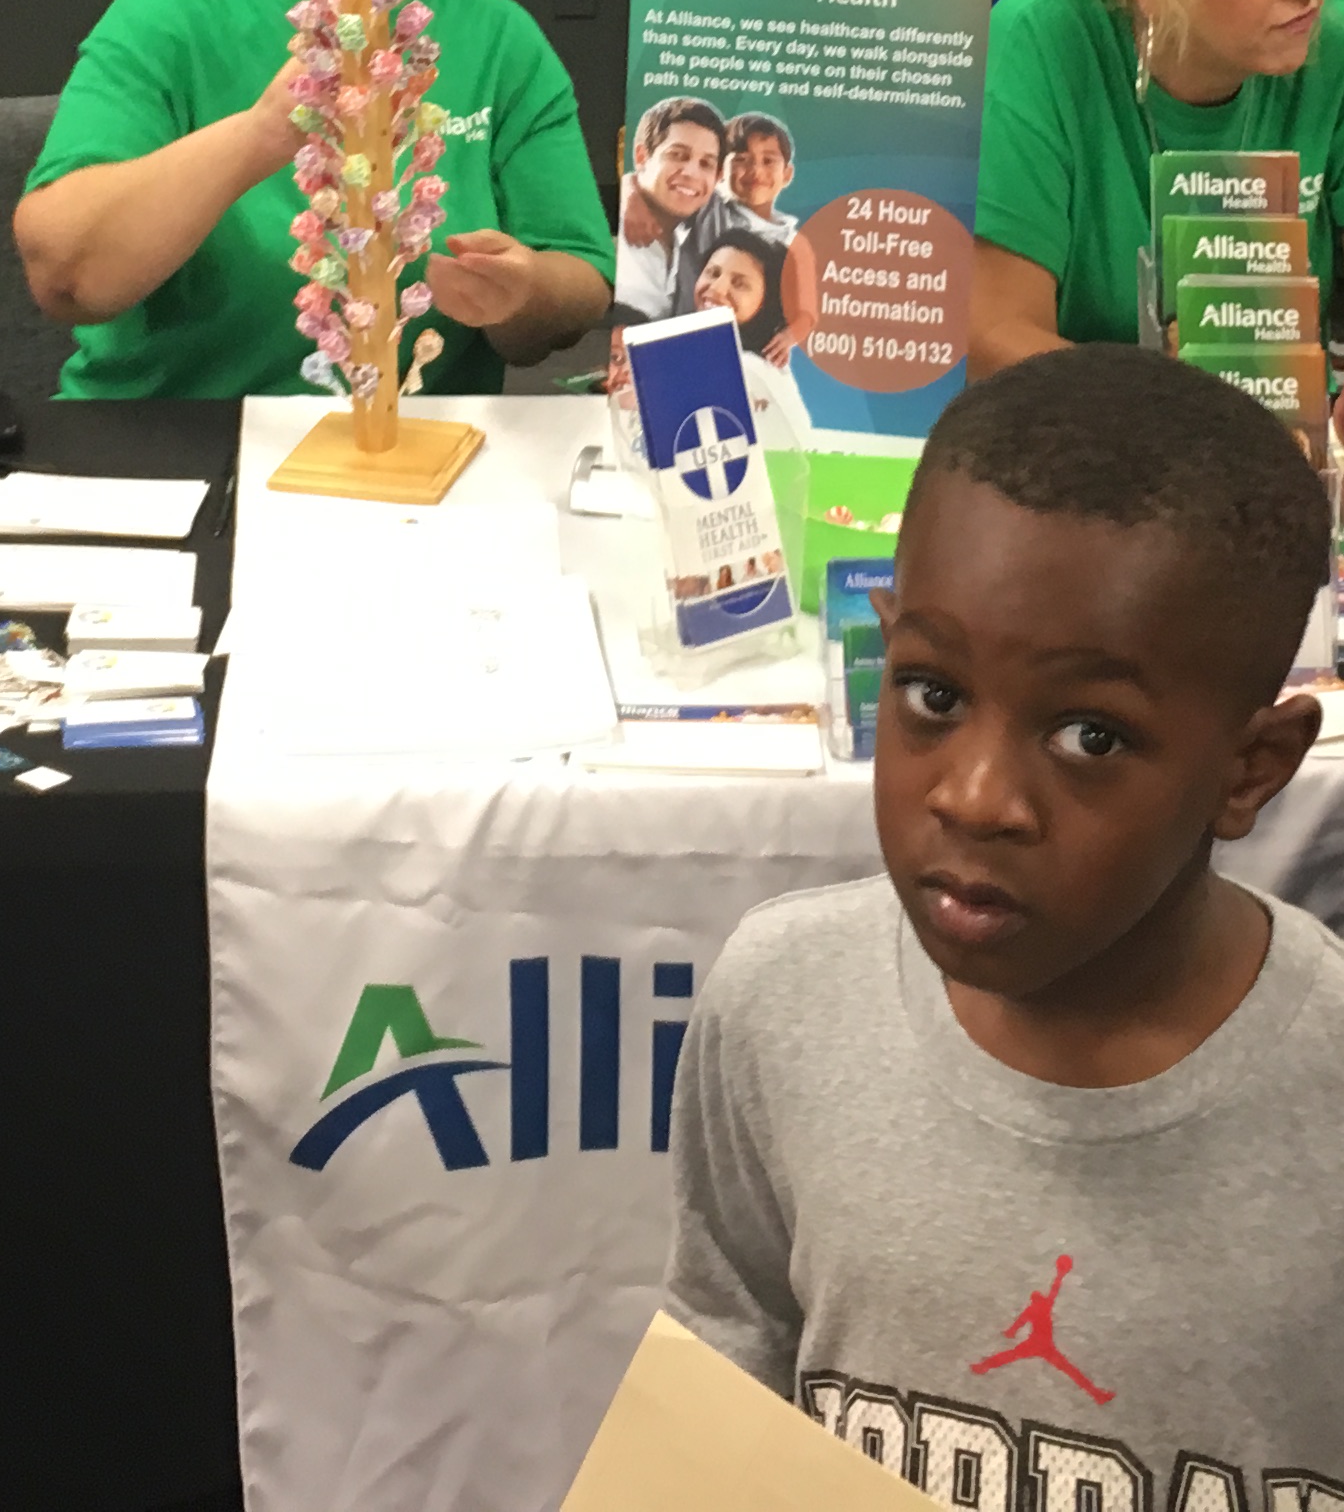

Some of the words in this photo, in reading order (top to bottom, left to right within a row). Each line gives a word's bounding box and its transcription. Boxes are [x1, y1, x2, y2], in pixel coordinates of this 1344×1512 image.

[644, 8, 663, 24] At
[665, 9, 736, 32] Alliance,
[739, 18, 763, 31] we
[767, 20, 796, 34] see
[800, 19, 886, 40] healthcare
[889, 26, 974, 50] differently
[642, 29, 678, 46] than
[681, 33, 731, 50] some.
[735, 35, 783, 56] Every
[785, 39, 819, 59] day,
[823, 45, 847, 58] we
[850, 45, 888, 61] walk
[892, 48, 974, 68] alongside
[659, 50, 686, 66] the
[689, 54, 745, 72] people
[748, 59, 772, 73] we
[775, 61, 821, 76] serve
[824, 65, 846, 78] on
[849, 64, 888, 82] their
[891, 68, 953, 86] chosen
[643, 71, 679, 87] path
[682, 73, 700, 88] to
[703, 76, 775, 96] recovery
[778, 81, 810, 96] and
[813, 83, 966, 108] self-determination.
[1169, 171, 1267, 196] Alliance
[846, 197, 873, 220] 24
[878, 200, 931, 225] Hour
[1222, 195, 1269, 210] Health
[840, 229, 933, 258] Toll-Free
[1192, 235, 1291, 260] Alliance
[822, 260, 900, 288] Access
[906, 269, 947, 292] and
[1246, 260, 1292, 274] Health
[821, 292, 944, 324] Information
[1199, 302, 1300, 327] Alliance
[807, 330, 857, 361] (800)
[862, 337, 953, 364] 510-9132
[1254, 328, 1301, 341] Health
[692, 443, 732, 468] USA
[697, 501, 755, 533] MENTAL
[699, 517, 759, 549] HEALTH
